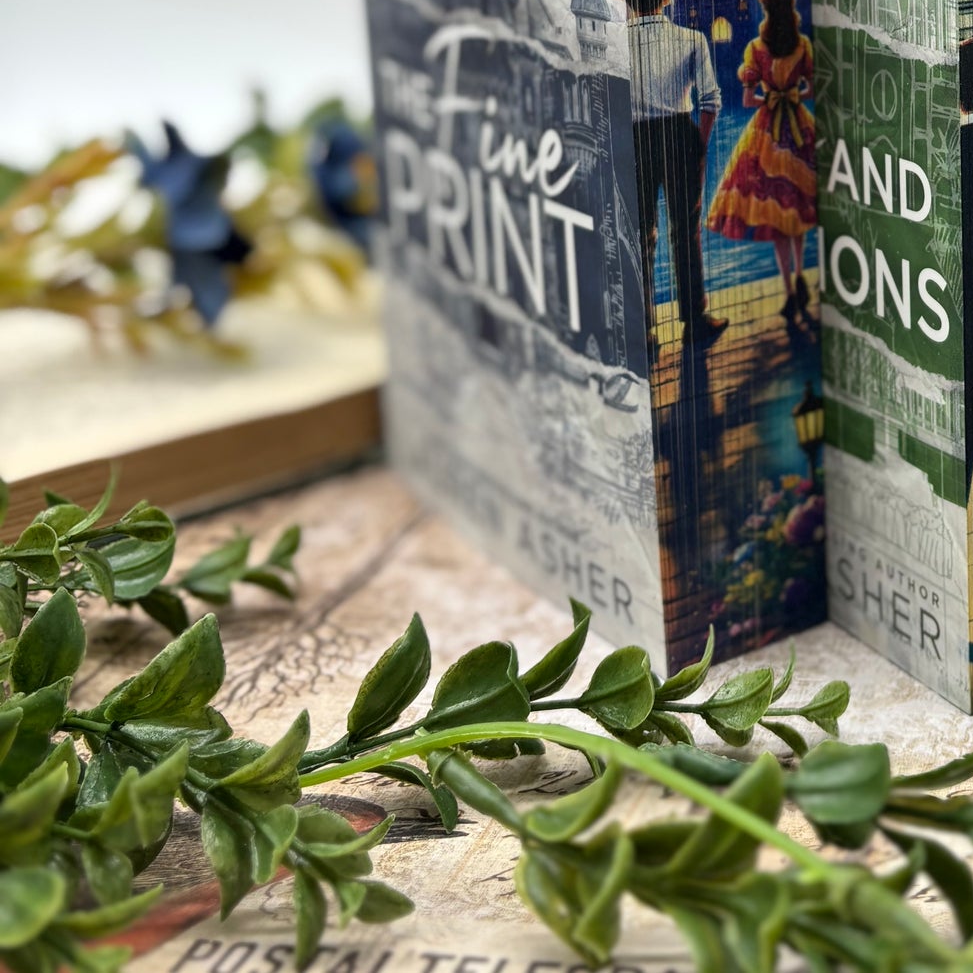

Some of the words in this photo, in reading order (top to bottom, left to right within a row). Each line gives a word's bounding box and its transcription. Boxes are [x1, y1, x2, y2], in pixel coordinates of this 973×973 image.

[424, 22, 580, 197] Fine
[385, 125, 595, 333] PRINT
[826, 138, 932, 223] AND
[515, 515, 635, 625] ASHER
[837, 556, 942, 662] SHER
[876, 559, 940, 609] AUTHOR
